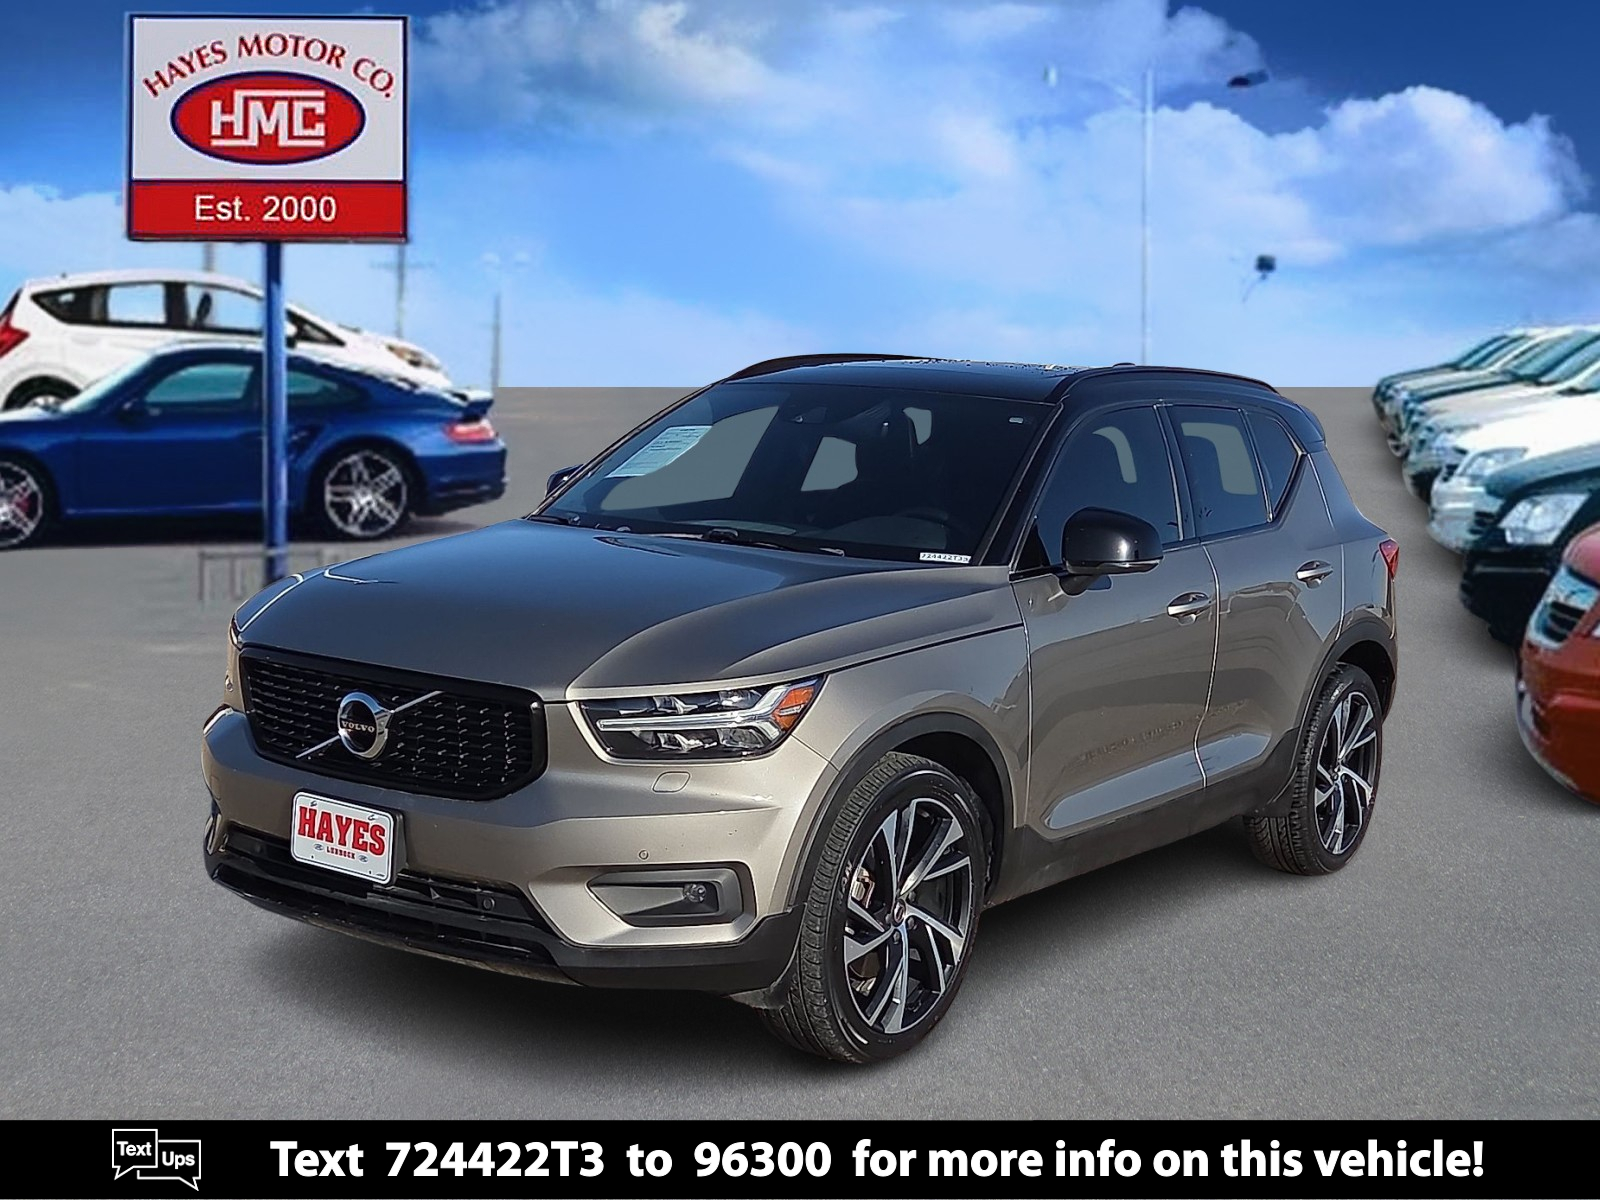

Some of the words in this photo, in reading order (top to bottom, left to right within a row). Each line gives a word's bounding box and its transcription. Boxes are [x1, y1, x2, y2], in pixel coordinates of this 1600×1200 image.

[142, 40, 228, 97] HAYES
[238, 33, 347, 69] MOTOR
[352, 58, 394, 98] CO.
[210, 89, 326, 147] HMC
[194, 195, 250, 221] Est.
[262, 195, 337, 222] 2000
[341, 720, 375, 733] VOLVO
[298, 806, 386, 856] HAYES
